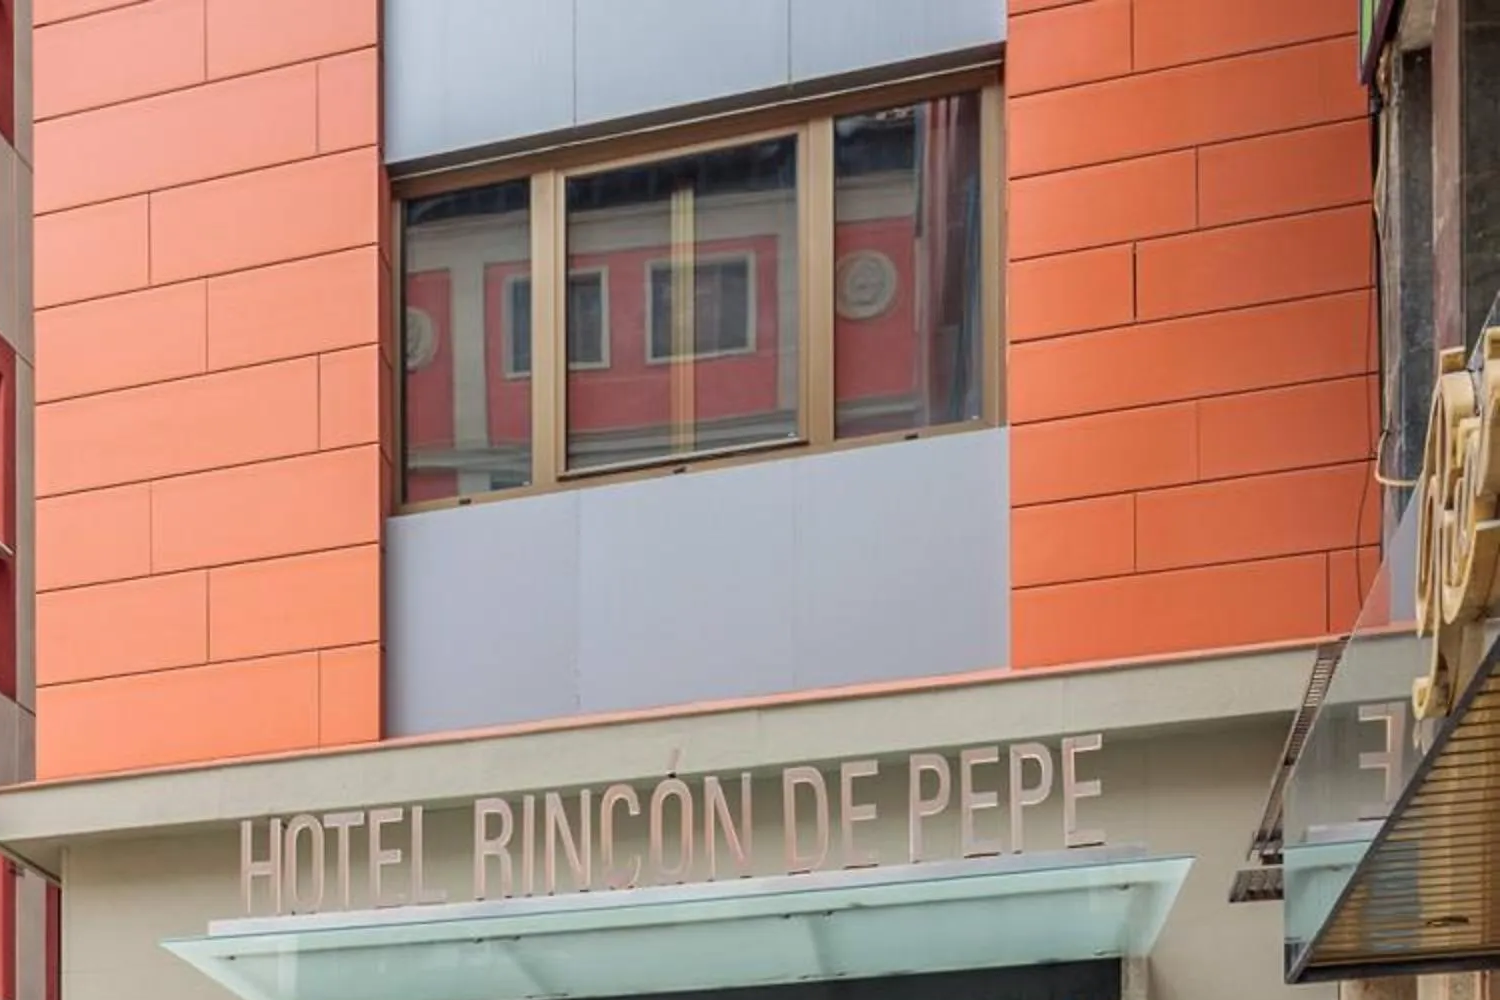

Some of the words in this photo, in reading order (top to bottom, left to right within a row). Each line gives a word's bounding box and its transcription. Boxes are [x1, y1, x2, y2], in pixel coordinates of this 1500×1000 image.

[240, 805, 448, 916] HOTEL
[474, 740, 752, 900] RINCÓN
[782, 757, 880, 876] DE
[908, 732, 1106, 864] PEPE
